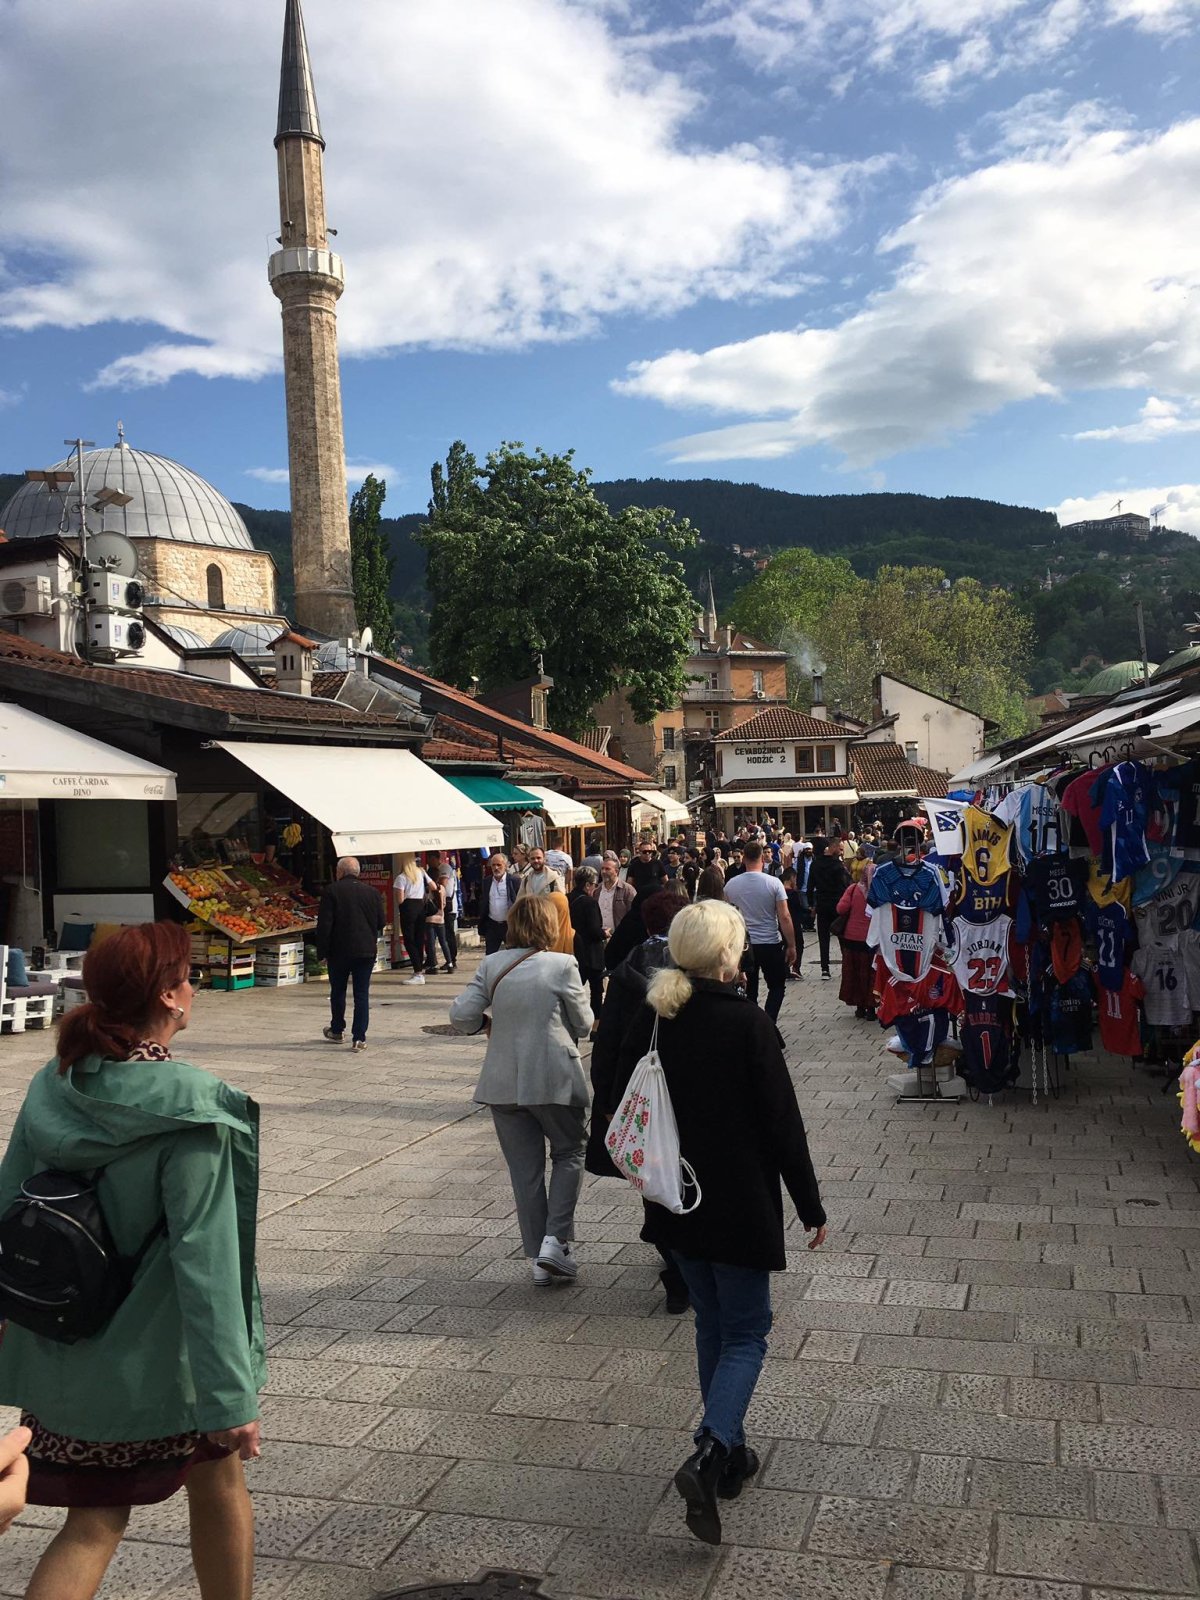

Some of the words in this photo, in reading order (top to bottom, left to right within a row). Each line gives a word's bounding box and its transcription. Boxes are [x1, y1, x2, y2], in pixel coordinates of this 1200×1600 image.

[53, 778, 78, 786] CAFFE
[972, 828, 1001, 847] JAMES
[975, 847, 990, 882] 6
[1047, 877, 1074, 900] 30
[1177, 883, 1191, 896] JR
[1158, 900, 1193, 934] 20
[967, 940, 1002, 956] JORDAN
[967, 956, 1003, 990] 23
[1156, 968, 1178, 991] 16
[917, 1013, 936, 1052] 7
[980, 1030, 992, 1070] 1
